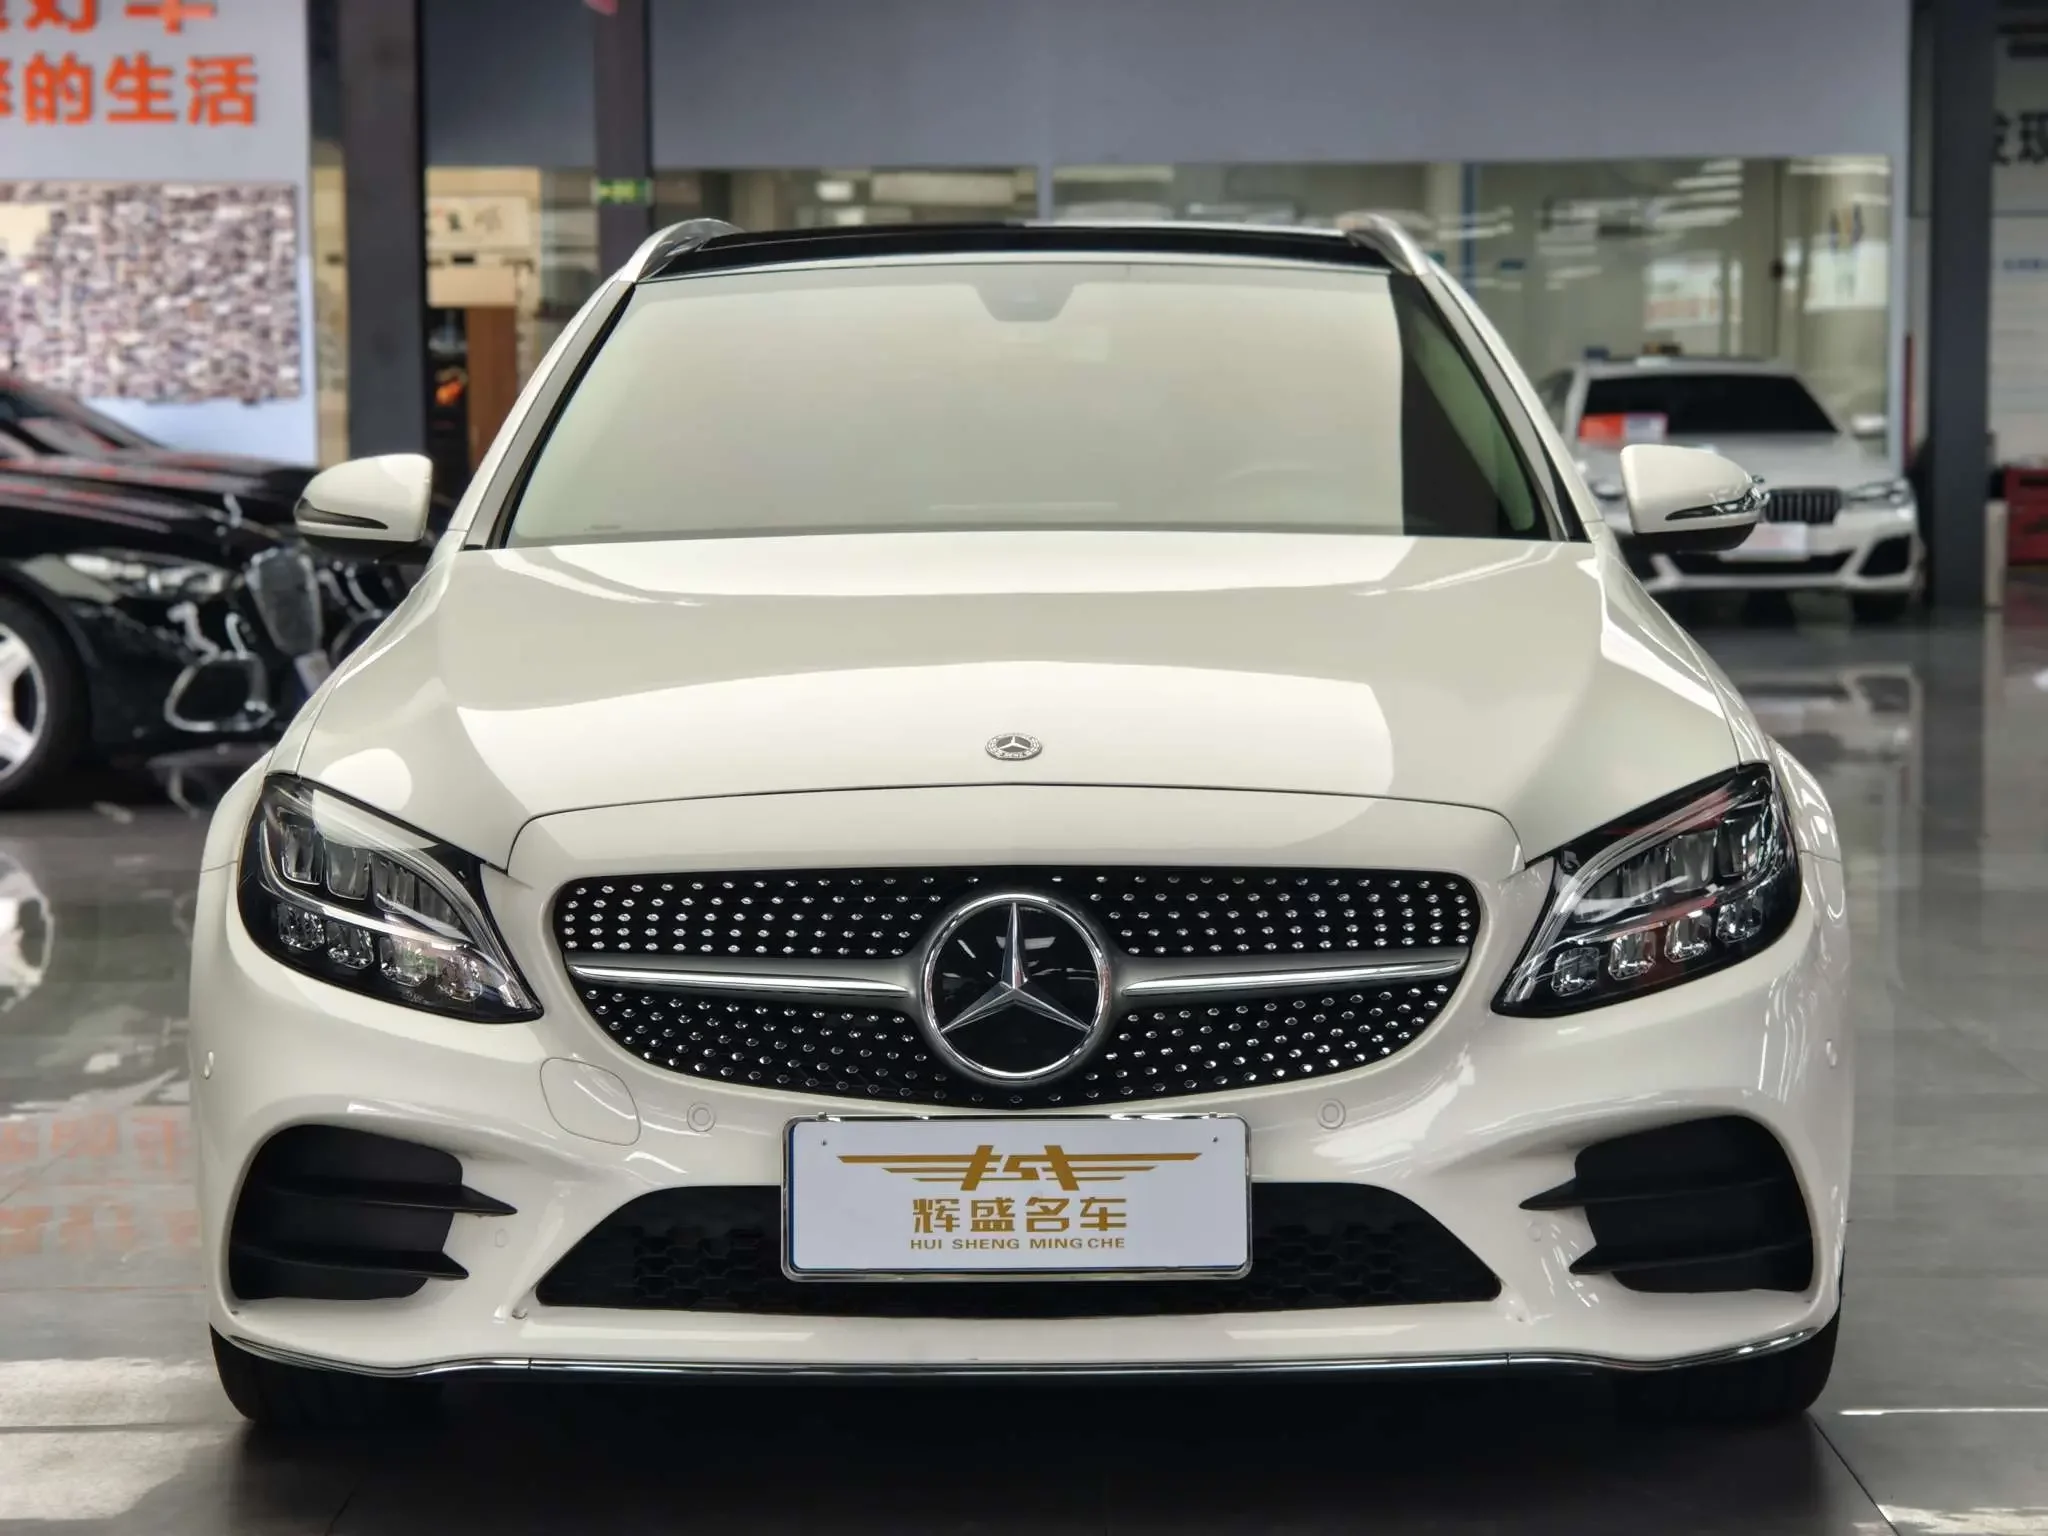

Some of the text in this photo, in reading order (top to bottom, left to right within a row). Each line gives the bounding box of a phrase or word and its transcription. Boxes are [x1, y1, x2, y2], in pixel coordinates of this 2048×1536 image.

[0, 52, 258, 127] 的生活
[912, 1196, 1127, 1234] 辉盛名车
[910, 1237, 1125, 1250] HUI SHENG MING CHE
